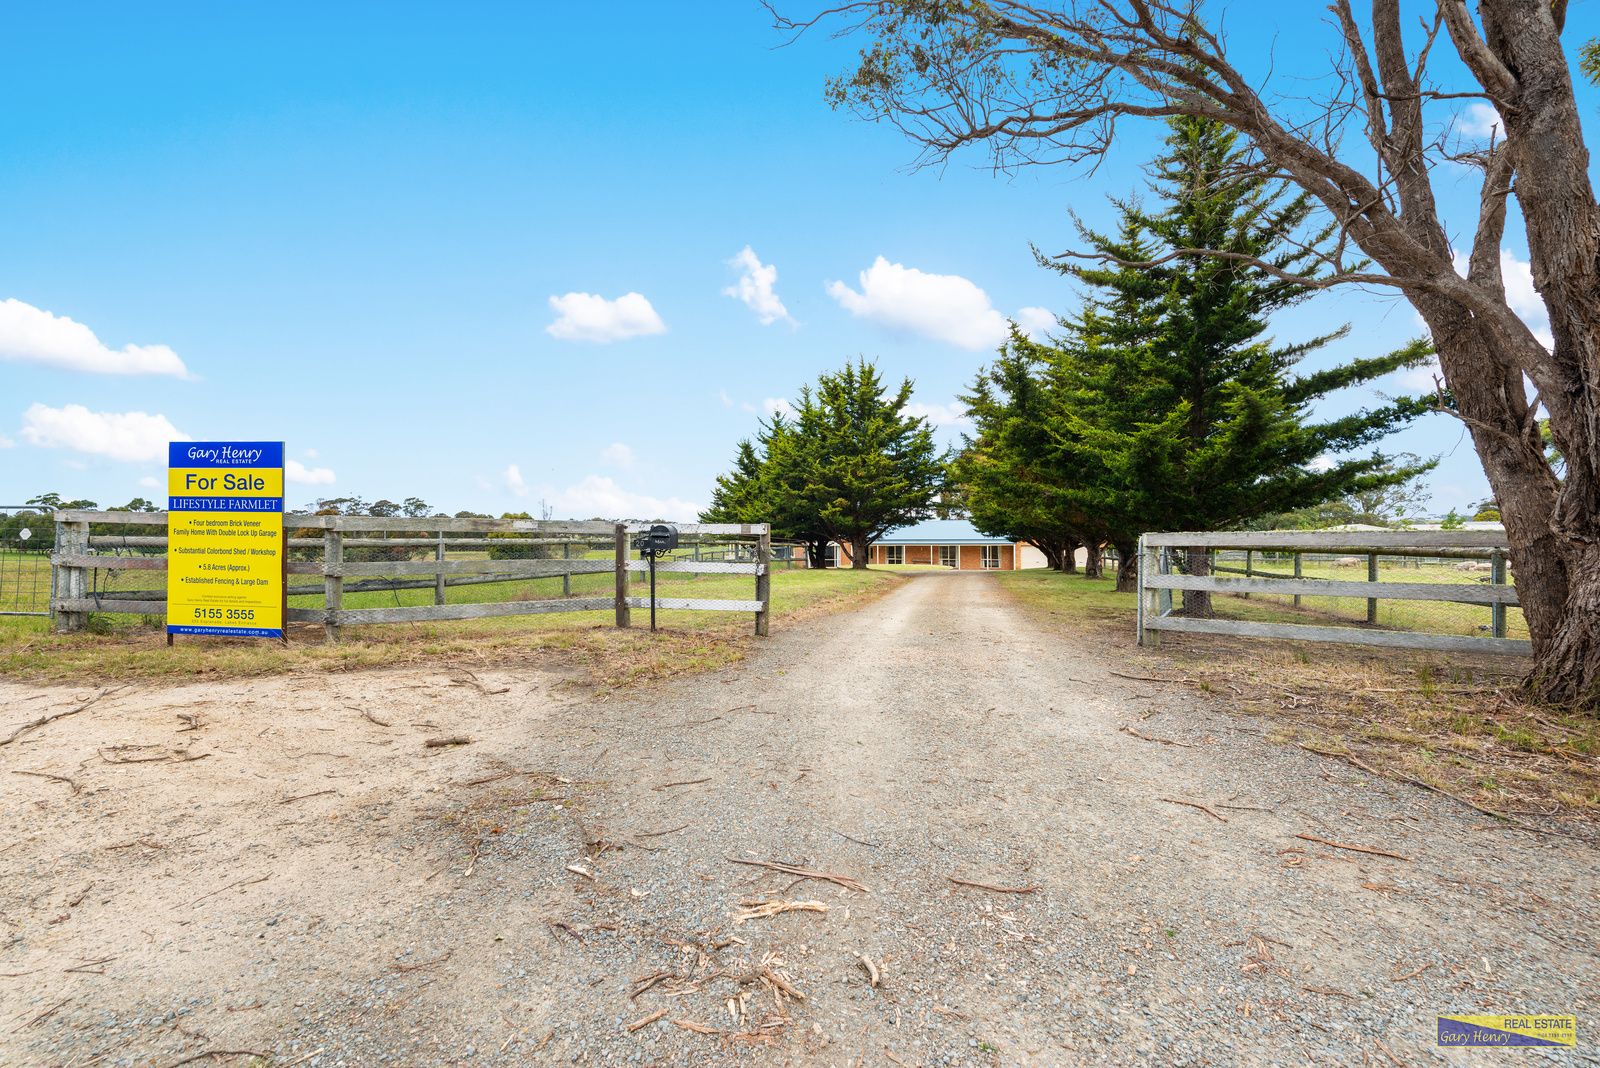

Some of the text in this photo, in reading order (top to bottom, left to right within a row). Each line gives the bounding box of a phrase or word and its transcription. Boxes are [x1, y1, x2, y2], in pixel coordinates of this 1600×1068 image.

[188, 445, 262, 462] Gary Henry
[186, 473, 265, 491] For Sale
[173, 499, 277, 510] LIFESTYLE FARMLET
[173, 528, 189, 536] Family
[237, 529, 249, 537] Lock
[250, 529, 257, 538] Up
[258, 529, 277, 538] Garage
[178, 547, 206, 555] Substantial
[207, 547, 232, 555] Colorbond
[233, 547, 246, 555] Shed
[250, 548, 276, 556] Workshop
[203, 563, 250, 572] 5.8 Acres (Approx.)
[185, 577, 213, 585] Established
[214, 577, 234, 586] Fencing
[240, 578, 255, 586] Large
[256, 578, 269, 586] Dam
[194, 607, 255, 620] 5155 3555
[180, 627, 269, 636] www.garyhenryrealestate.com.au
